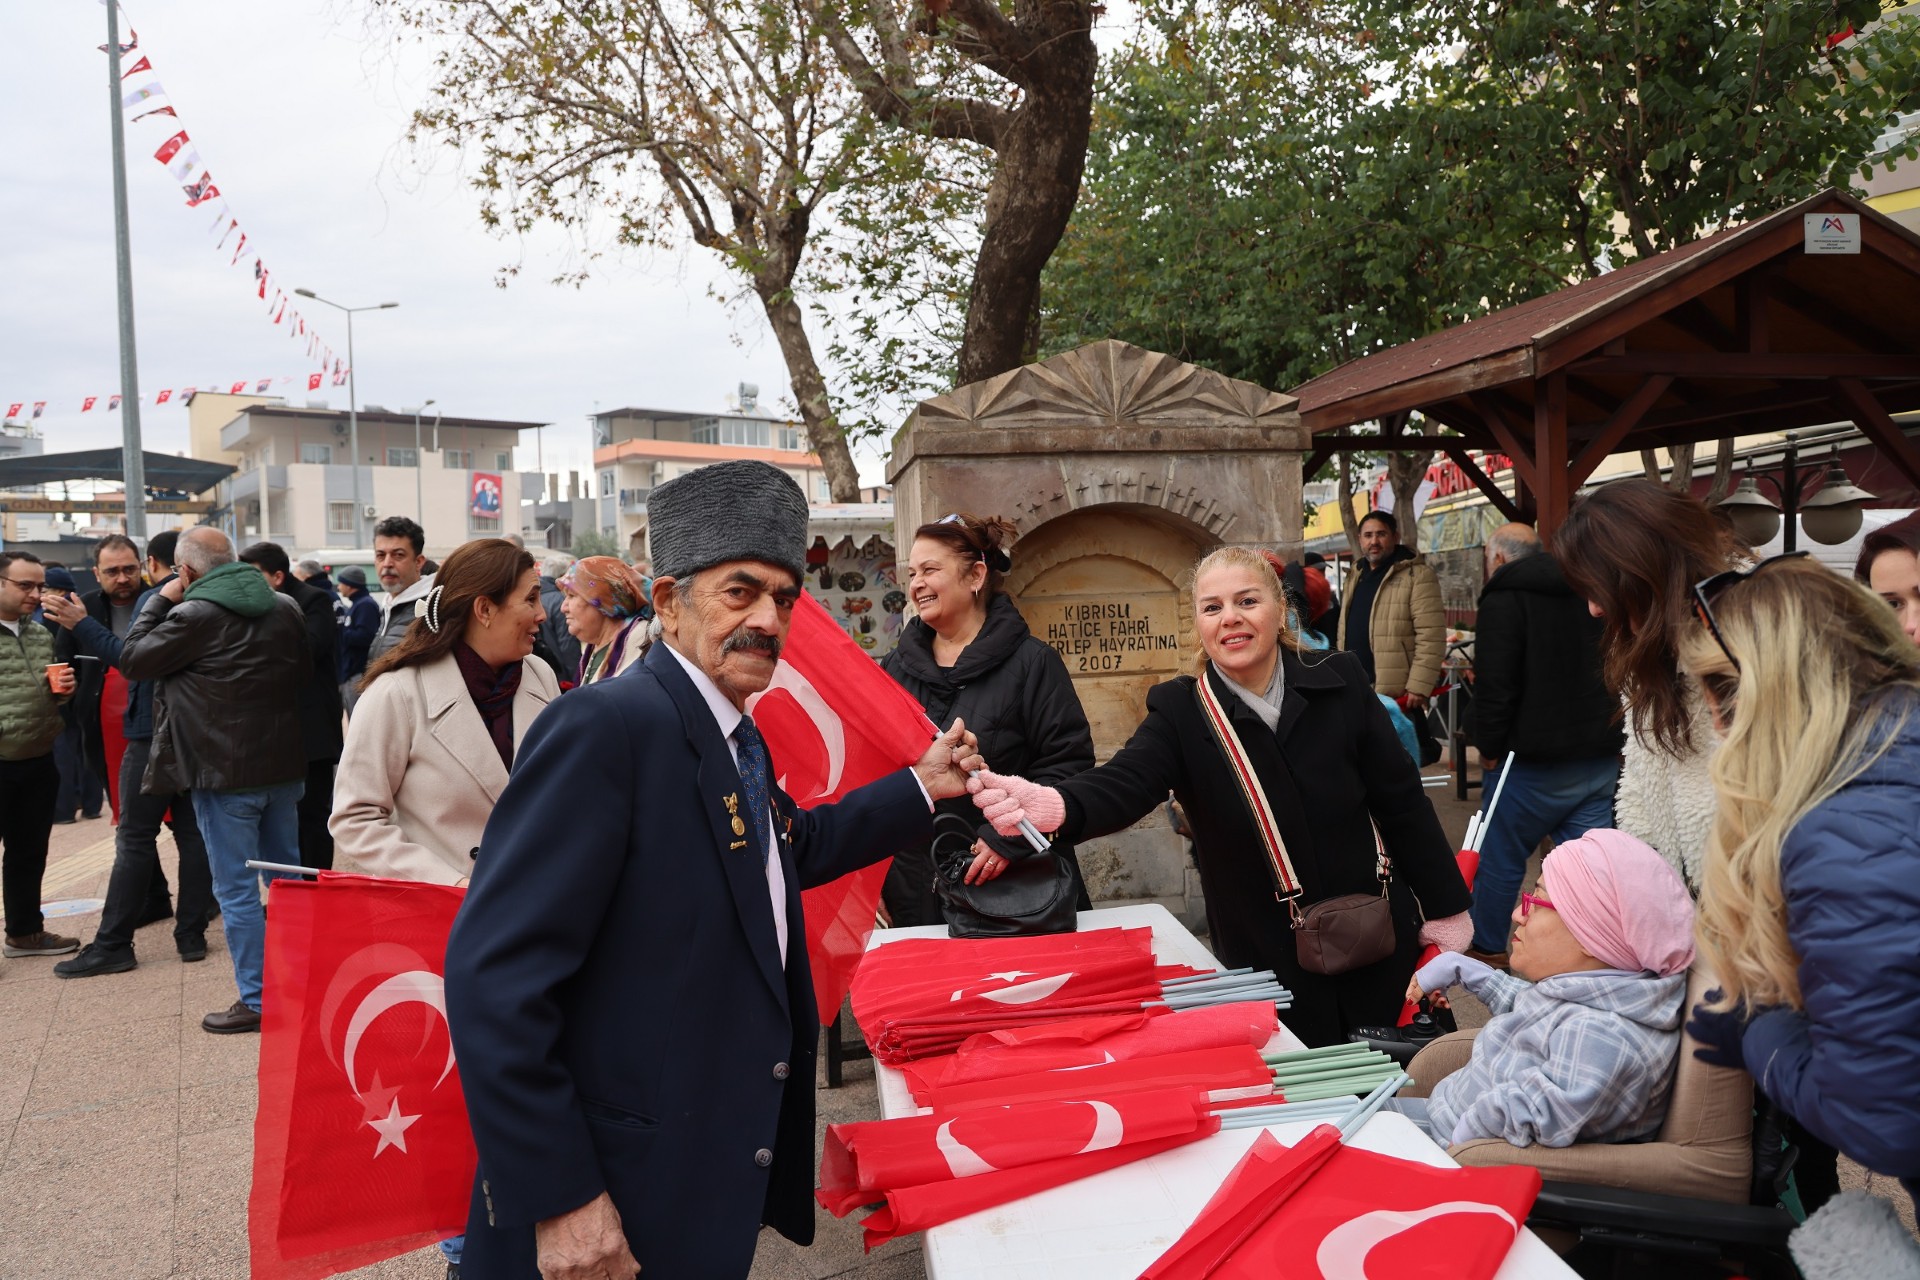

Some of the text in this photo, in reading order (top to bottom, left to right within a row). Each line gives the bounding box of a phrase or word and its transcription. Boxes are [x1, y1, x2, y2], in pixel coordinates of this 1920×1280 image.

[1064, 603, 1130, 621] KIBRISLI
[1048, 616, 1149, 639] HATİCE FAHRİ
[1100, 634, 1177, 652] HAYRATINA
[1079, 655, 1122, 672] 2007
